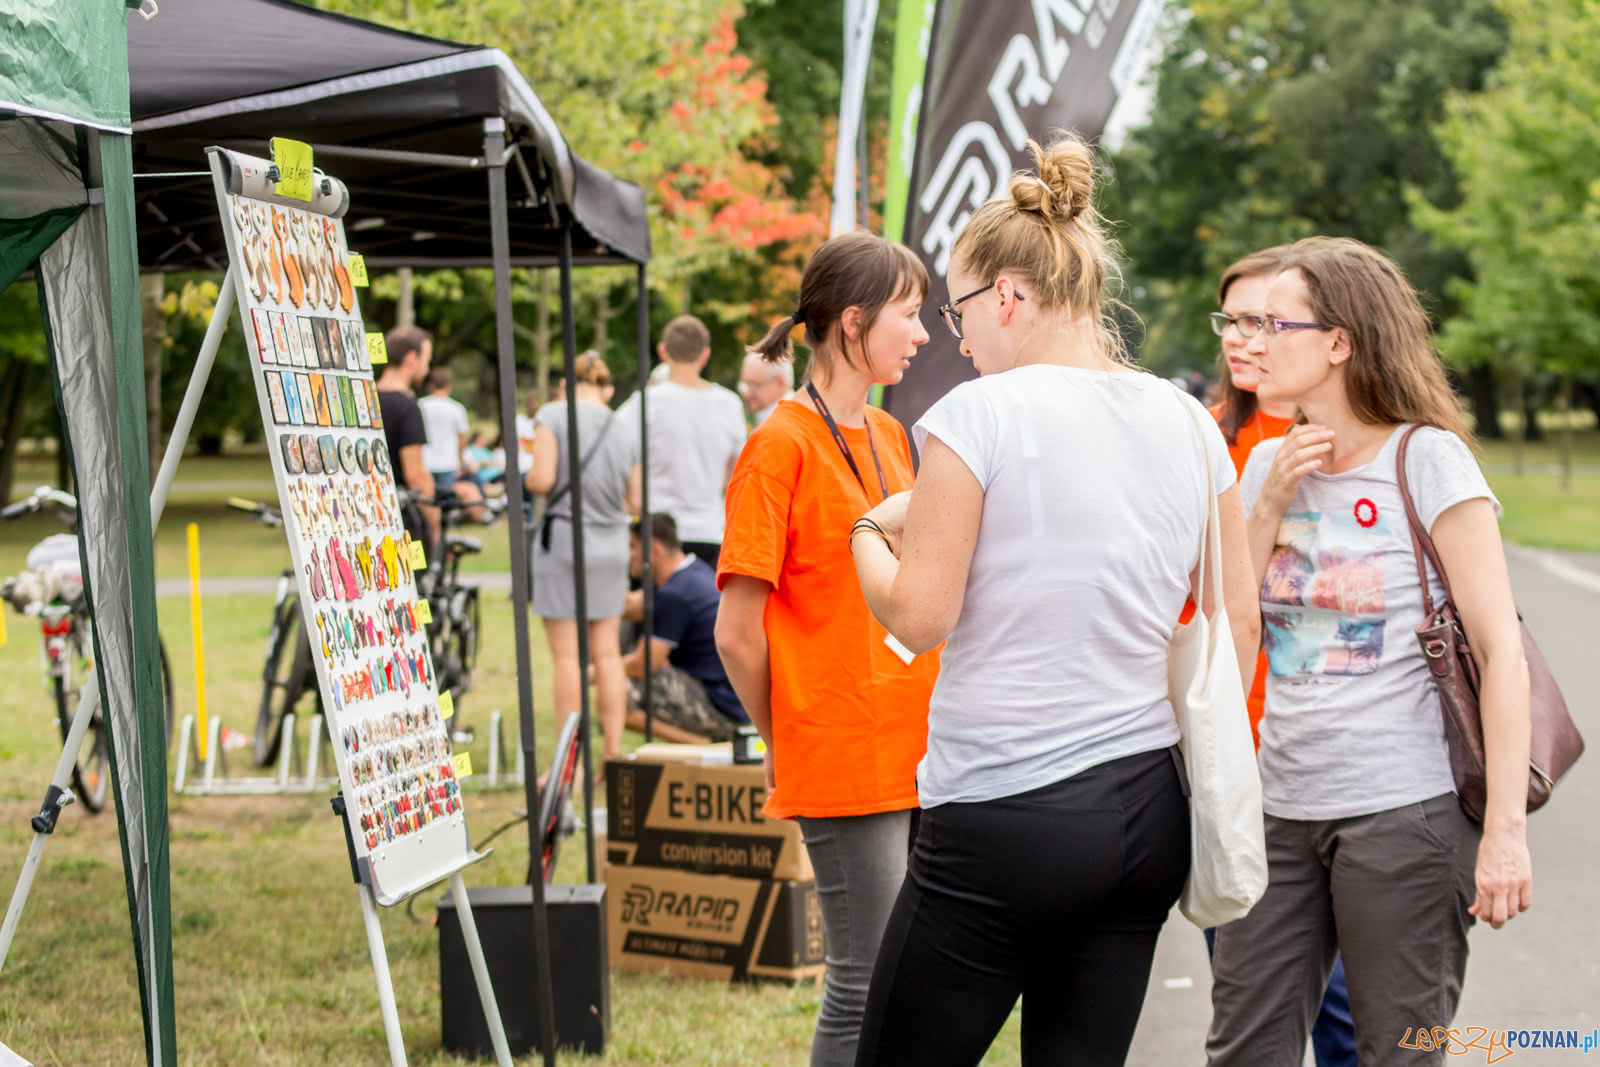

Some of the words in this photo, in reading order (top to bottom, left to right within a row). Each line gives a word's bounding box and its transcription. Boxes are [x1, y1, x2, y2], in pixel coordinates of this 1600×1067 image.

[661, 842, 747, 867] conversion
[751, 847, 773, 868] kit
[655, 889, 740, 923] RAPID
